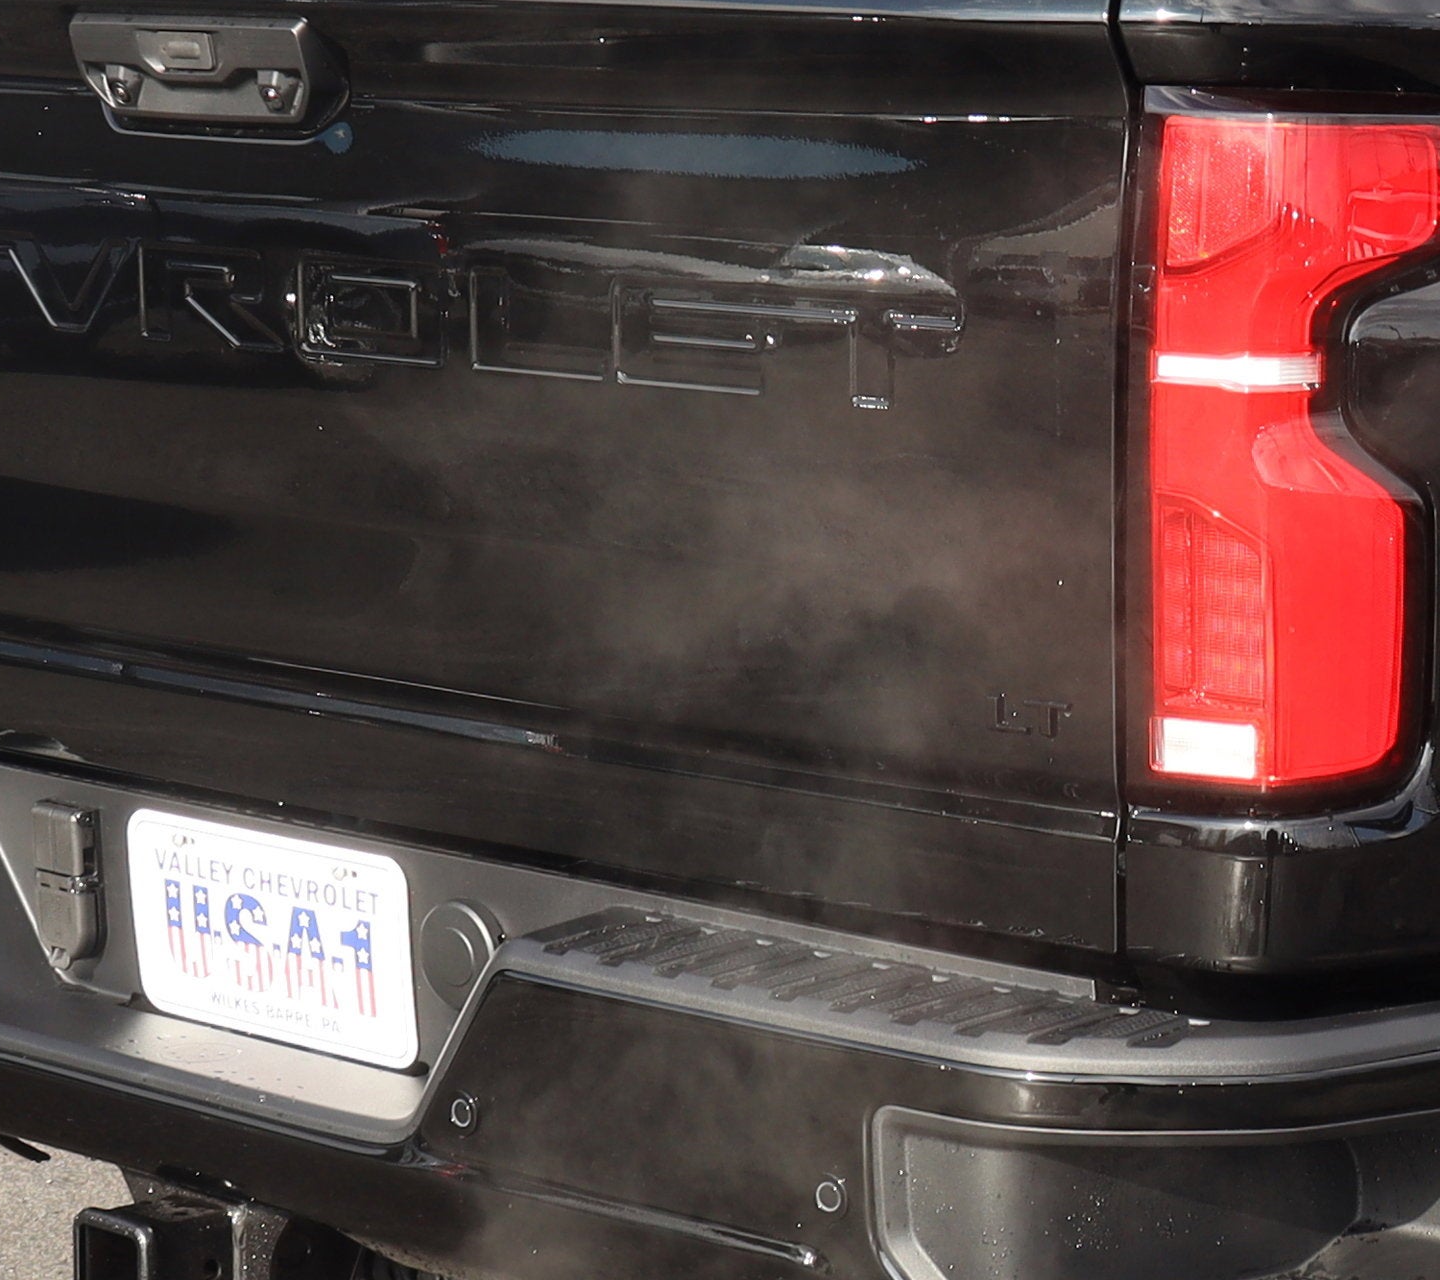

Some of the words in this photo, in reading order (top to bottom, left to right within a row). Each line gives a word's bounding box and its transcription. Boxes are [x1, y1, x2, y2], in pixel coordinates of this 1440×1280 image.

[987, 686, 1073, 739] LT
[154, 847, 234, 885] VALLEY
[242, 867, 379, 916] CHEVROLET
